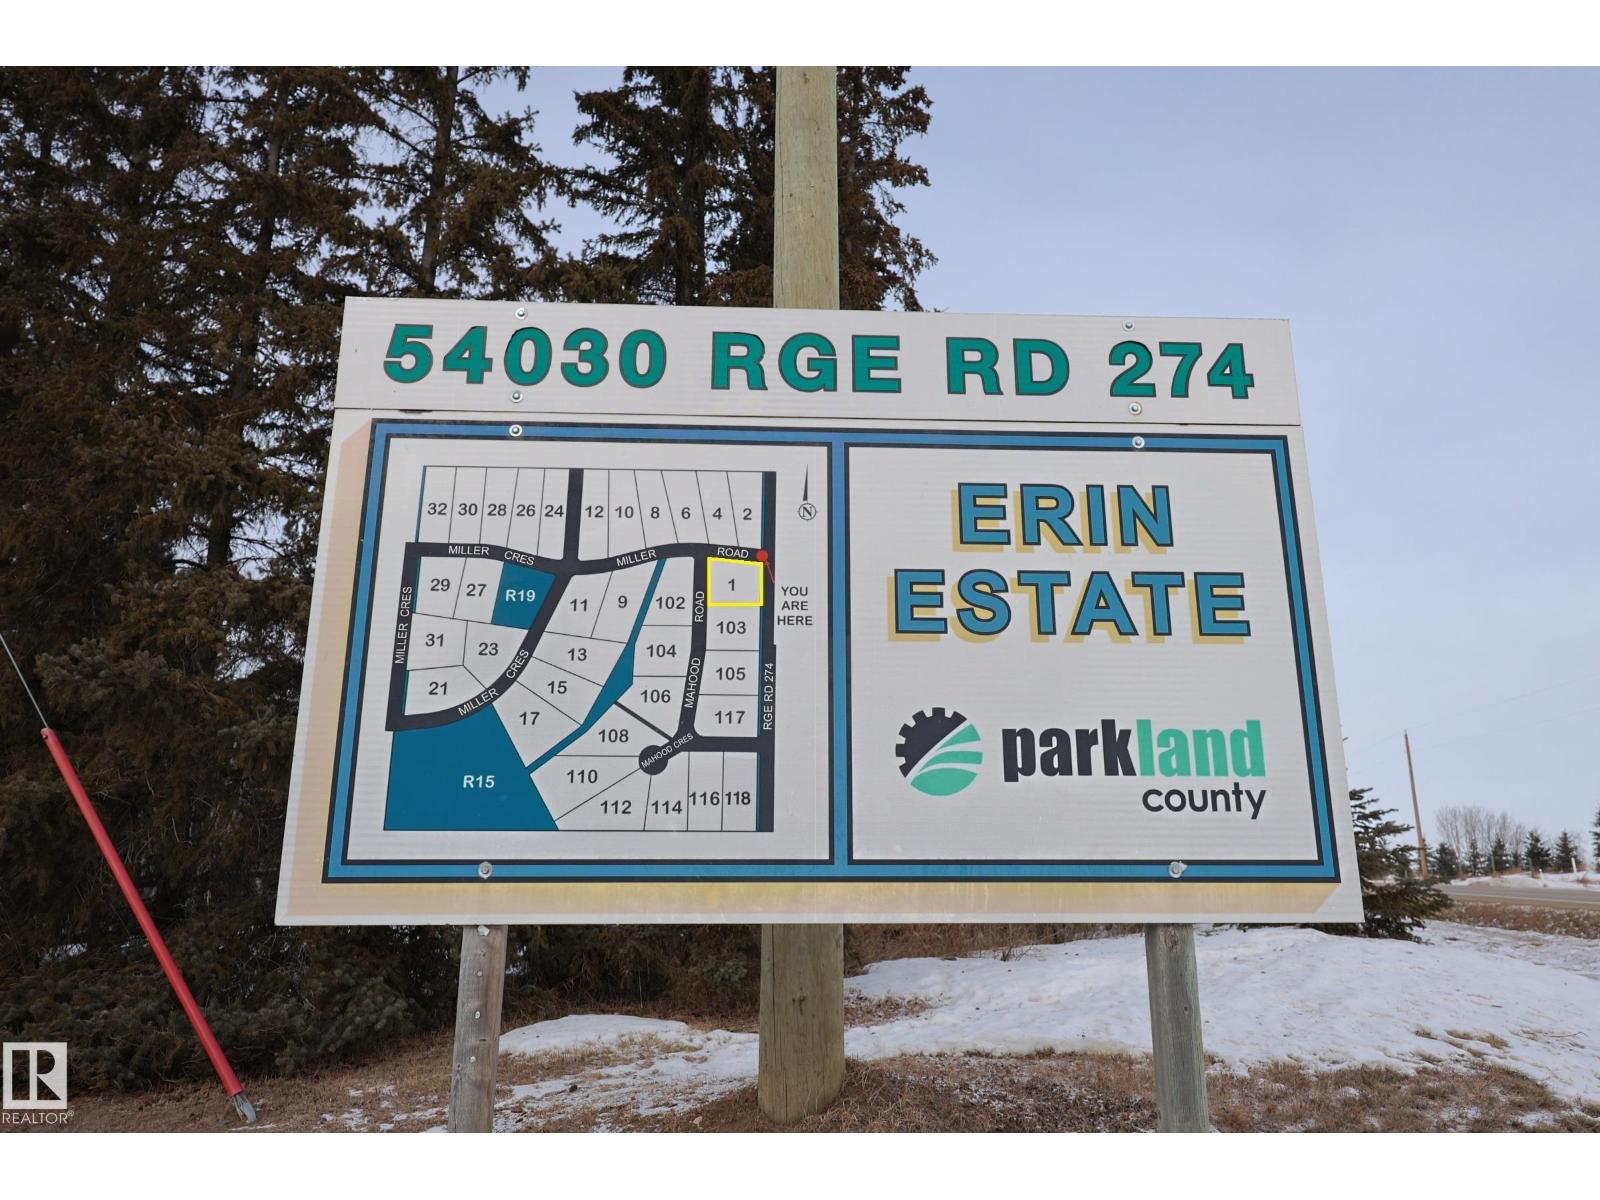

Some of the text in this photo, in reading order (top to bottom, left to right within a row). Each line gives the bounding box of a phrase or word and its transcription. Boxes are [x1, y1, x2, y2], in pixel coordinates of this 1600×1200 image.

[383, 323, 1255, 399] 54030 RGE RD 274
[427, 502, 447, 516] 32
[458, 503, 478, 516] 30
[487, 503, 507, 517] 28
[516, 504, 536, 517] 26
[544, 504, 564, 517] 24
[584, 505, 604, 518] 12
[615, 506, 634, 519] 10
[650, 506, 660, 519] 8
[681, 506, 690, 519] 6
[712, 507, 723, 520] 4
[742, 508, 752, 520] 2
[957, 482, 1174, 548] ERIN
[448, 545, 535, 566] MILLER CRES
[616, 547, 748, 567] MILLER ROAD
[430, 578, 450, 592] 29
[466, 584, 487, 597] 27
[728, 578, 735, 591] 1
[781, 586, 808, 597] YOU
[505, 589, 536, 602] R19
[618, 595, 627, 608] 9
[894, 568, 1251, 637] ESTATE
[570, 599, 588, 612] 11
[655, 596, 685, 610] 102
[781, 601, 808, 611] ARE
[394, 586, 413, 664] MILLER CRES
[716, 621, 746, 634] 103
[777, 615, 813, 626] HERE
[425, 633, 444, 647] 31
[478, 643, 499, 656] 23
[567, 648, 587, 661] 13
[646, 644, 677, 658] 104
[684, 591, 705, 708] MAHOOD ROAD
[715, 667, 746, 680] 105
[428, 681, 448, 695] 21
[457, 649, 529, 716] MILLER CRES
[547, 680, 567, 694] 15
[640, 690, 671, 703] 106
[763, 663, 774, 729] RGE RD 274
[519, 711, 540, 726] 17
[714, 711, 746, 725] 117
[598, 729, 629, 743] 108
[641, 732, 694, 769] MAHOOD CRES
[1002, 718, 1266, 783] parkland
[463, 775, 495, 788] R15
[567, 770, 598, 784] 110
[689, 792, 720, 806] 116
[724, 791, 751, 805] 118
[1141, 782, 1266, 820] county
[600, 801, 632, 814] 112
[651, 800, 682, 814] 114
